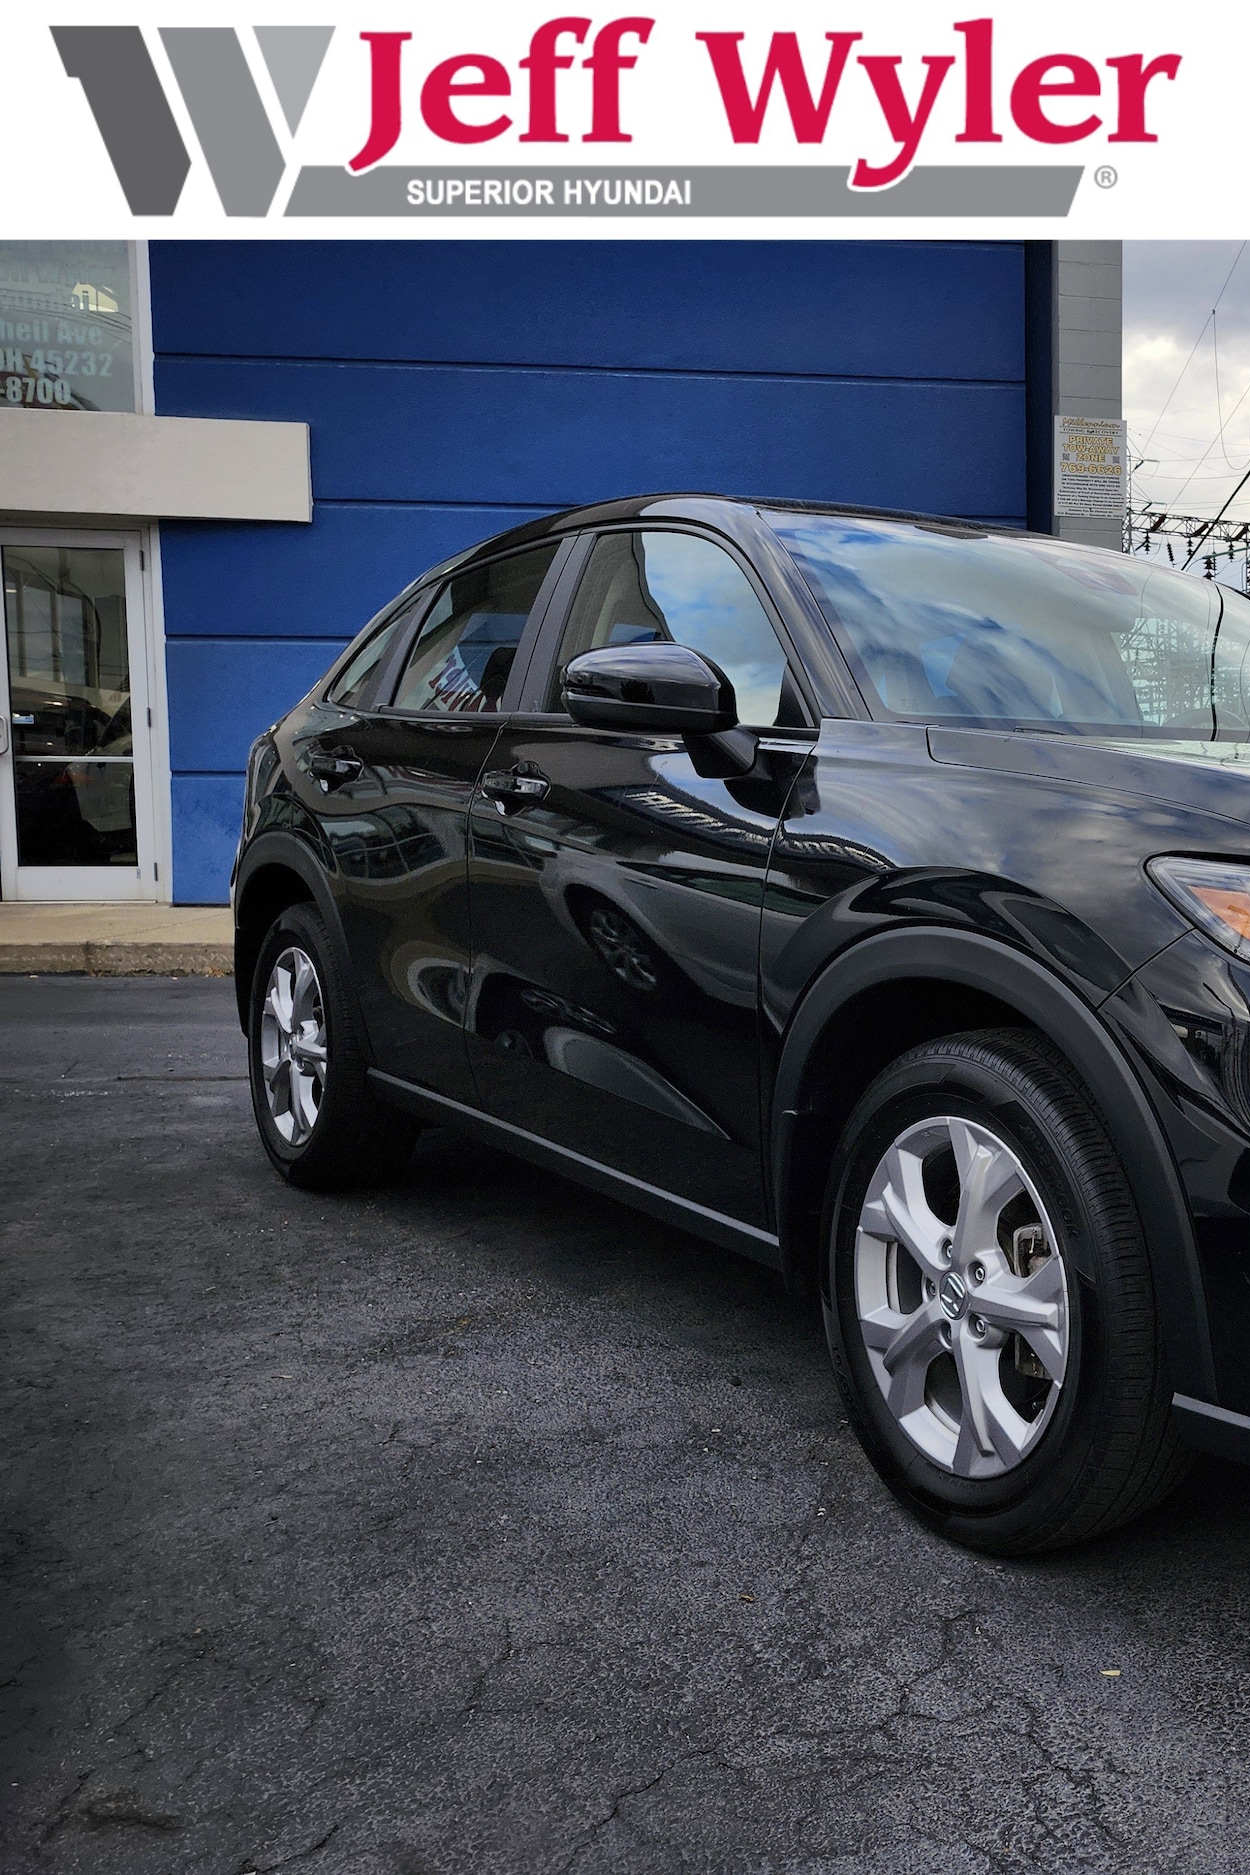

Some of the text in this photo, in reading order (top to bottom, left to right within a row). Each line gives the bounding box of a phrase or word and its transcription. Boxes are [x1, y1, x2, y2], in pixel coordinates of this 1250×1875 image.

[55, 319, 103, 345] Ave
[30, 349, 113, 378] 45232
[1069, 435, 1113, 446] PRIVATE
[1062, 443, 1120, 455] TOW-AWAY
[1076, 453, 1106, 462] ZONE
[1060, 462, 1122, 475] 769-6626
